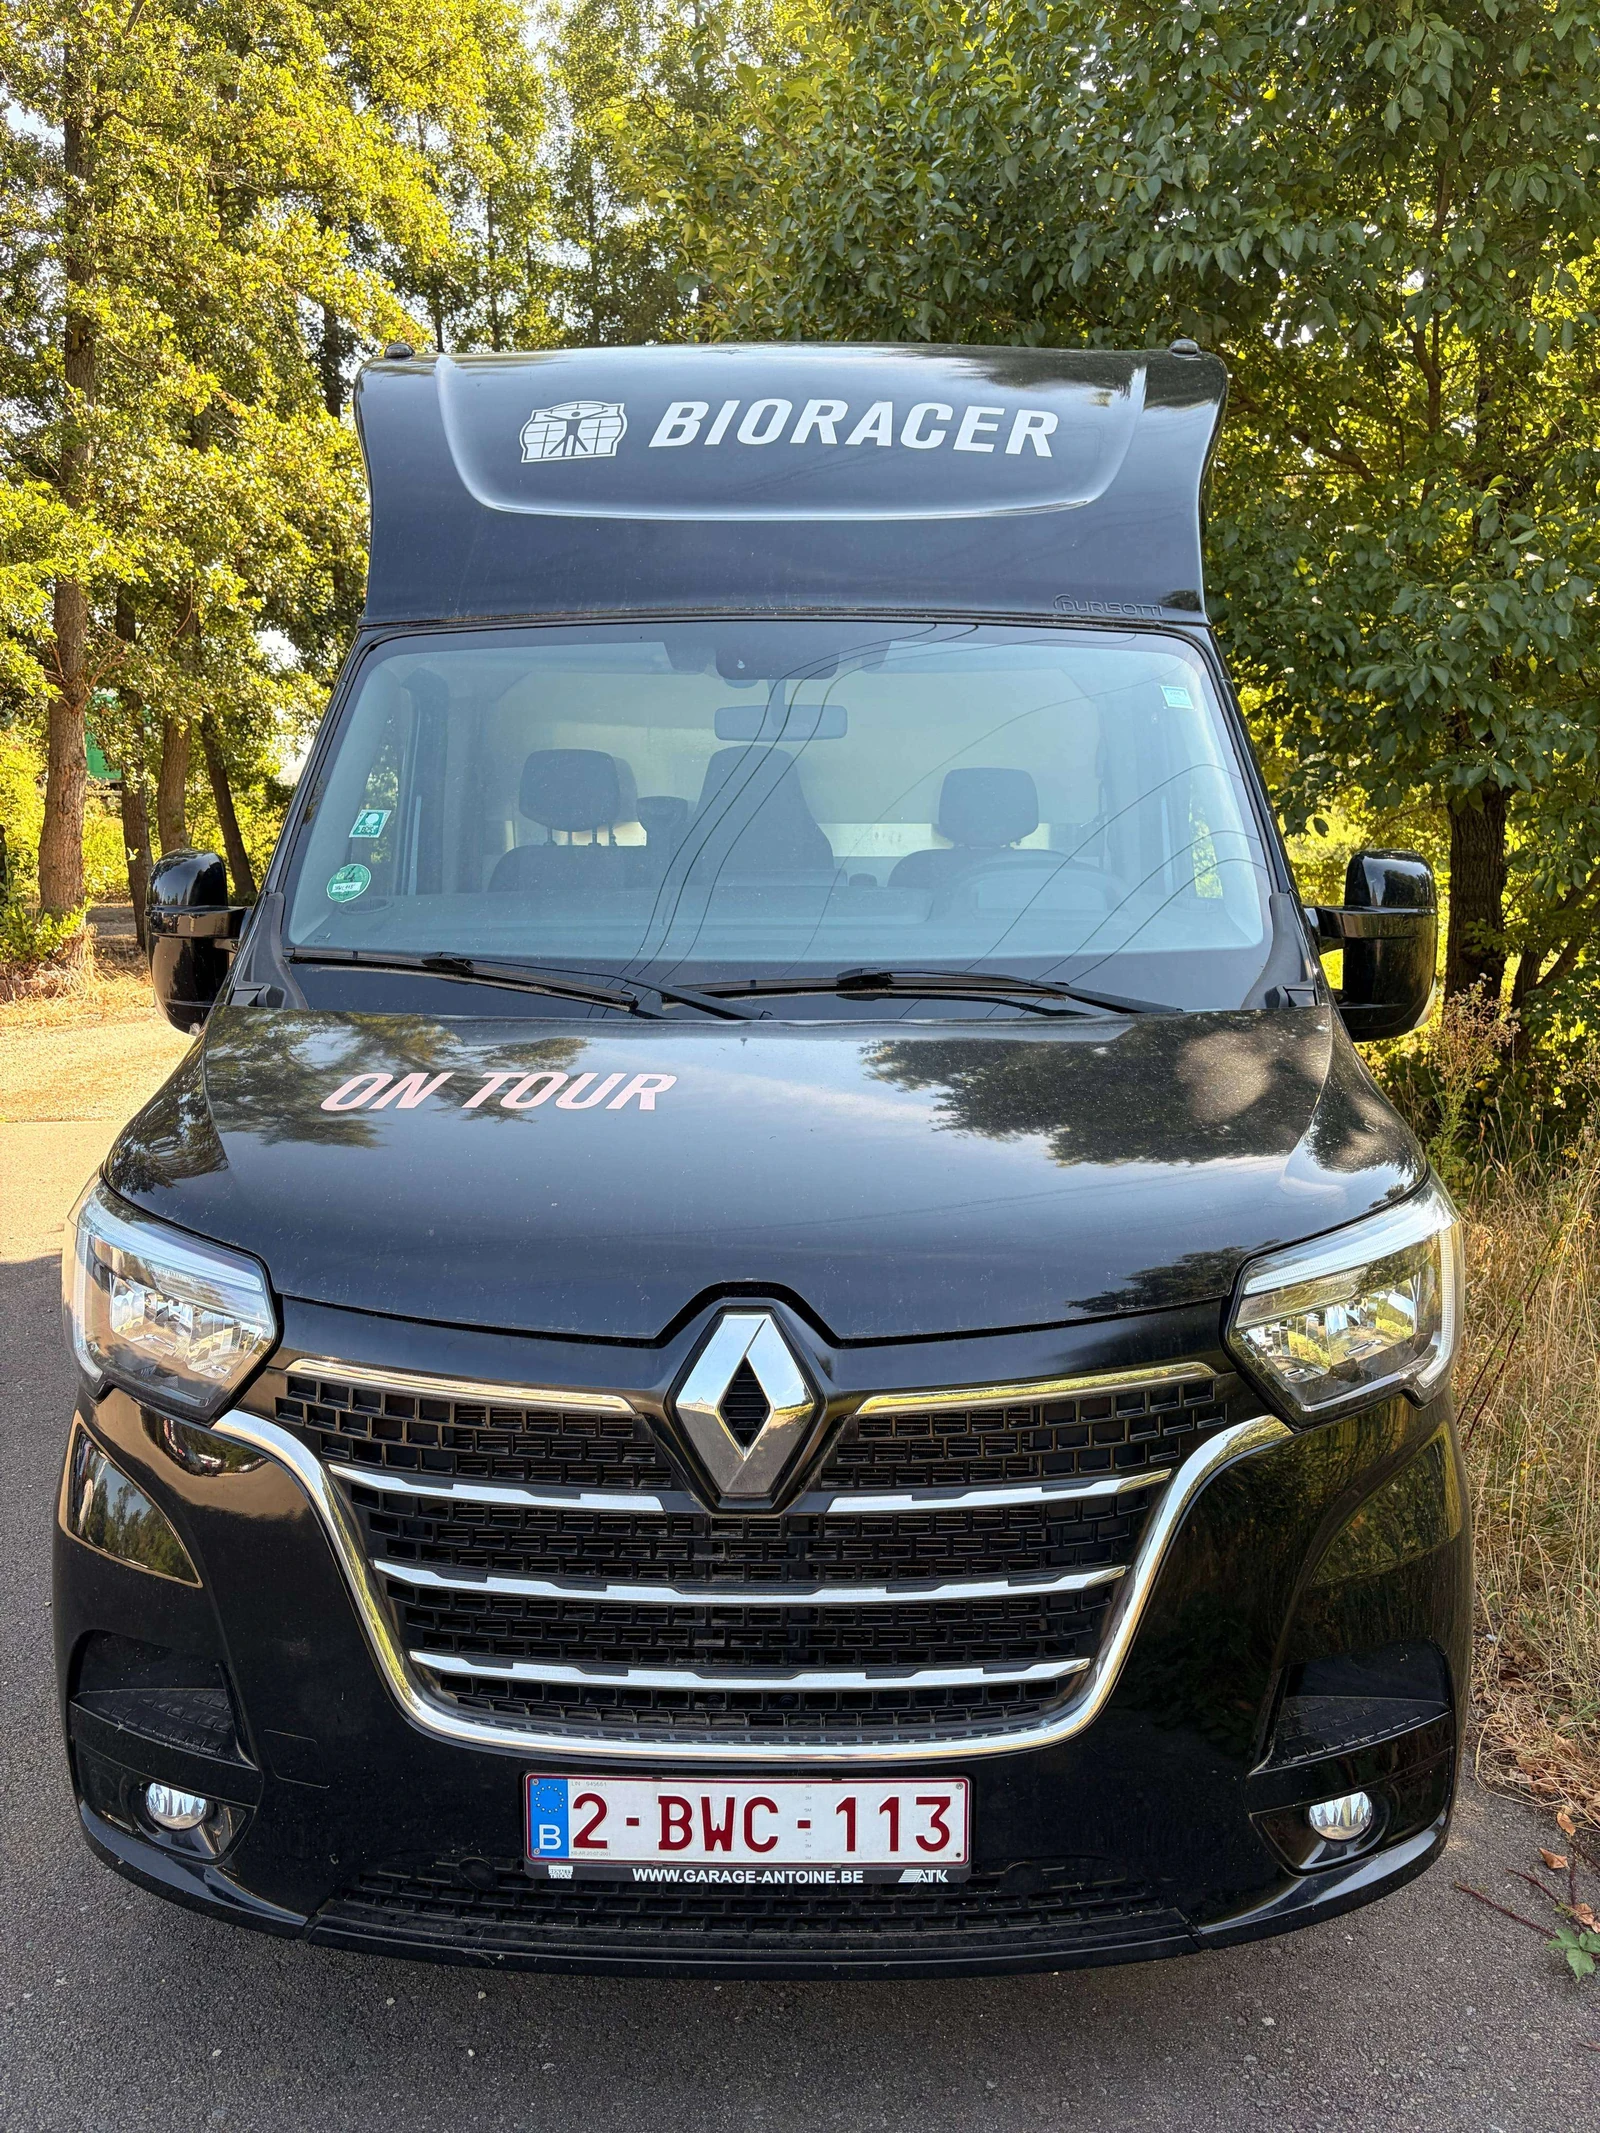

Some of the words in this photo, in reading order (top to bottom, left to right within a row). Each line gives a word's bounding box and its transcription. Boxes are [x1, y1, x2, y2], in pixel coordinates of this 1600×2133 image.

[648, 398, 1059, 457] BIORACER
[1054, 594, 1163, 616] DURISOTTI
[320, 1072, 455, 1111] ON
[461, 1071, 678, 1110] TOUR
[539, 1824, 562, 1850] B
[632, 1867, 864, 1884] WWW.GARAGE-ANTOINE.BE
[915, 1869, 949, 1883] ATK
